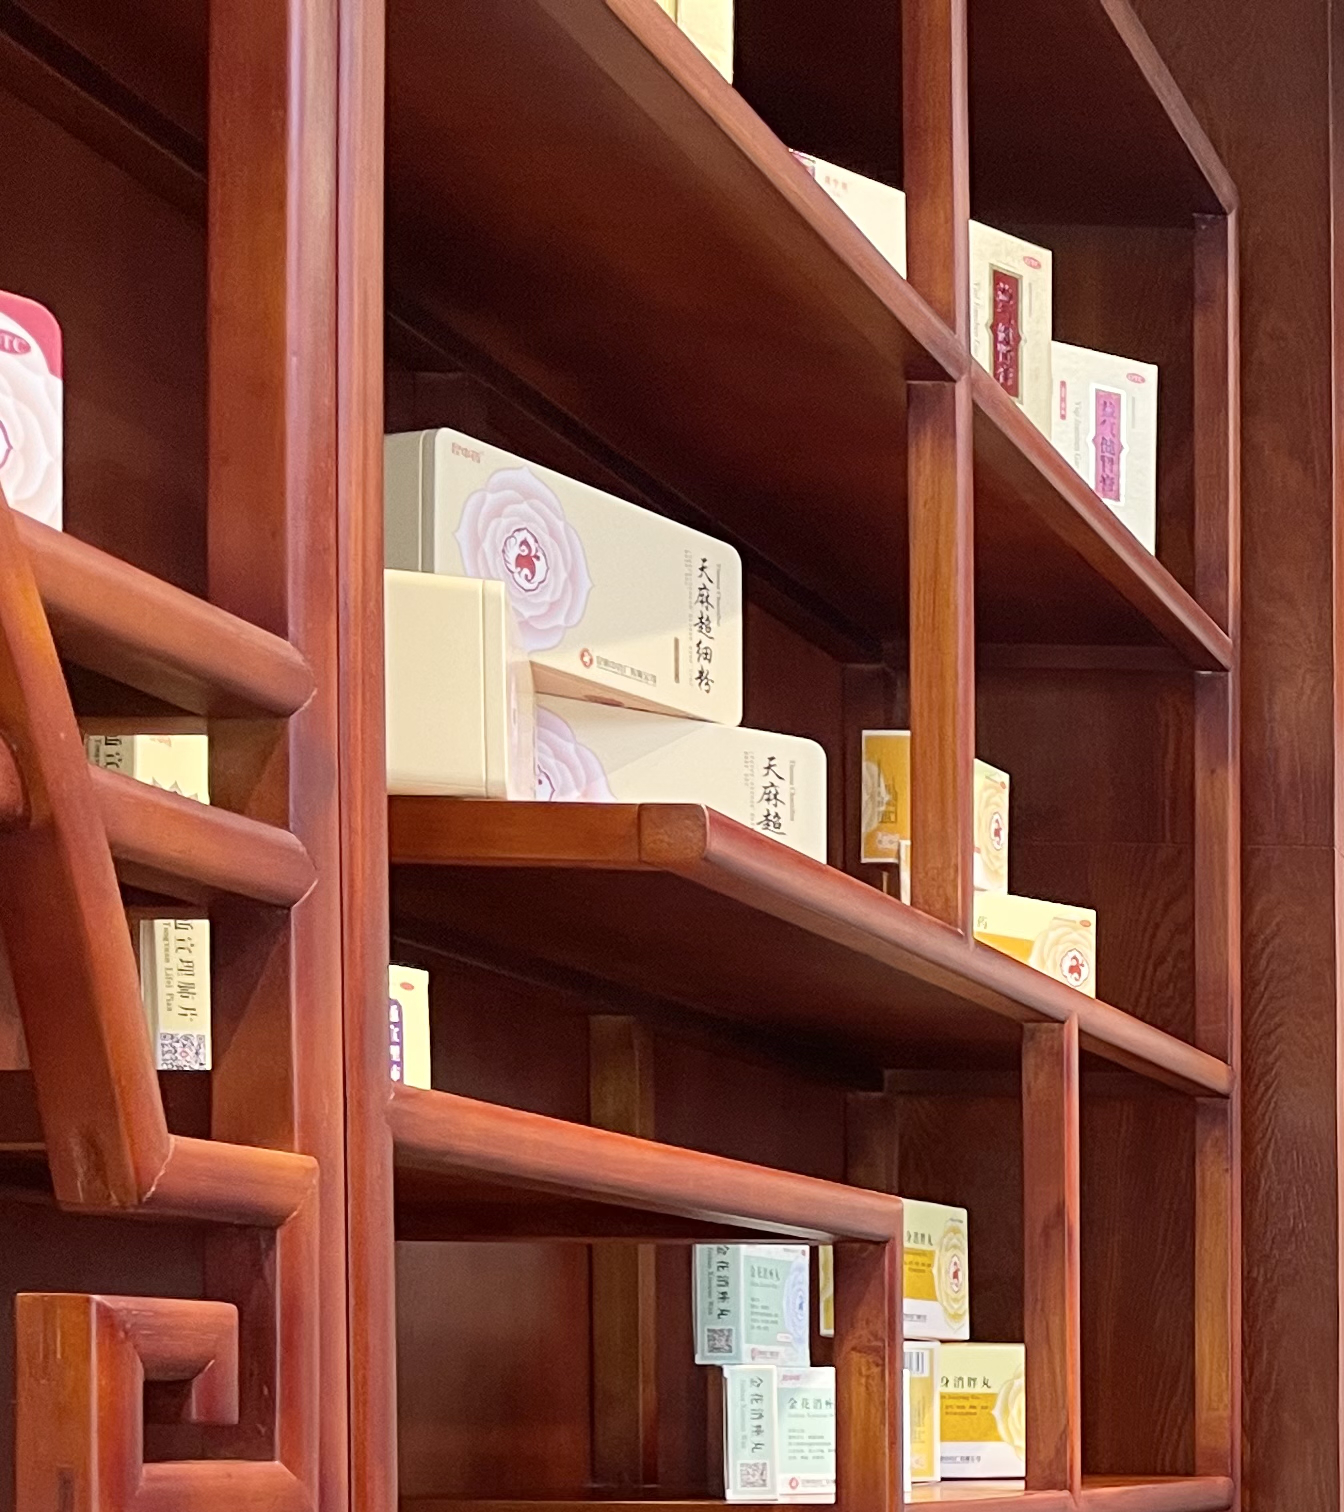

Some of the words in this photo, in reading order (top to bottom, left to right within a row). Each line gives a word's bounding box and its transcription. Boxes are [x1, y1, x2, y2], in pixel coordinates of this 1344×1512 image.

[0, 332, 23, 353] TC
[694, 557, 714, 694] 天麻超细粉
